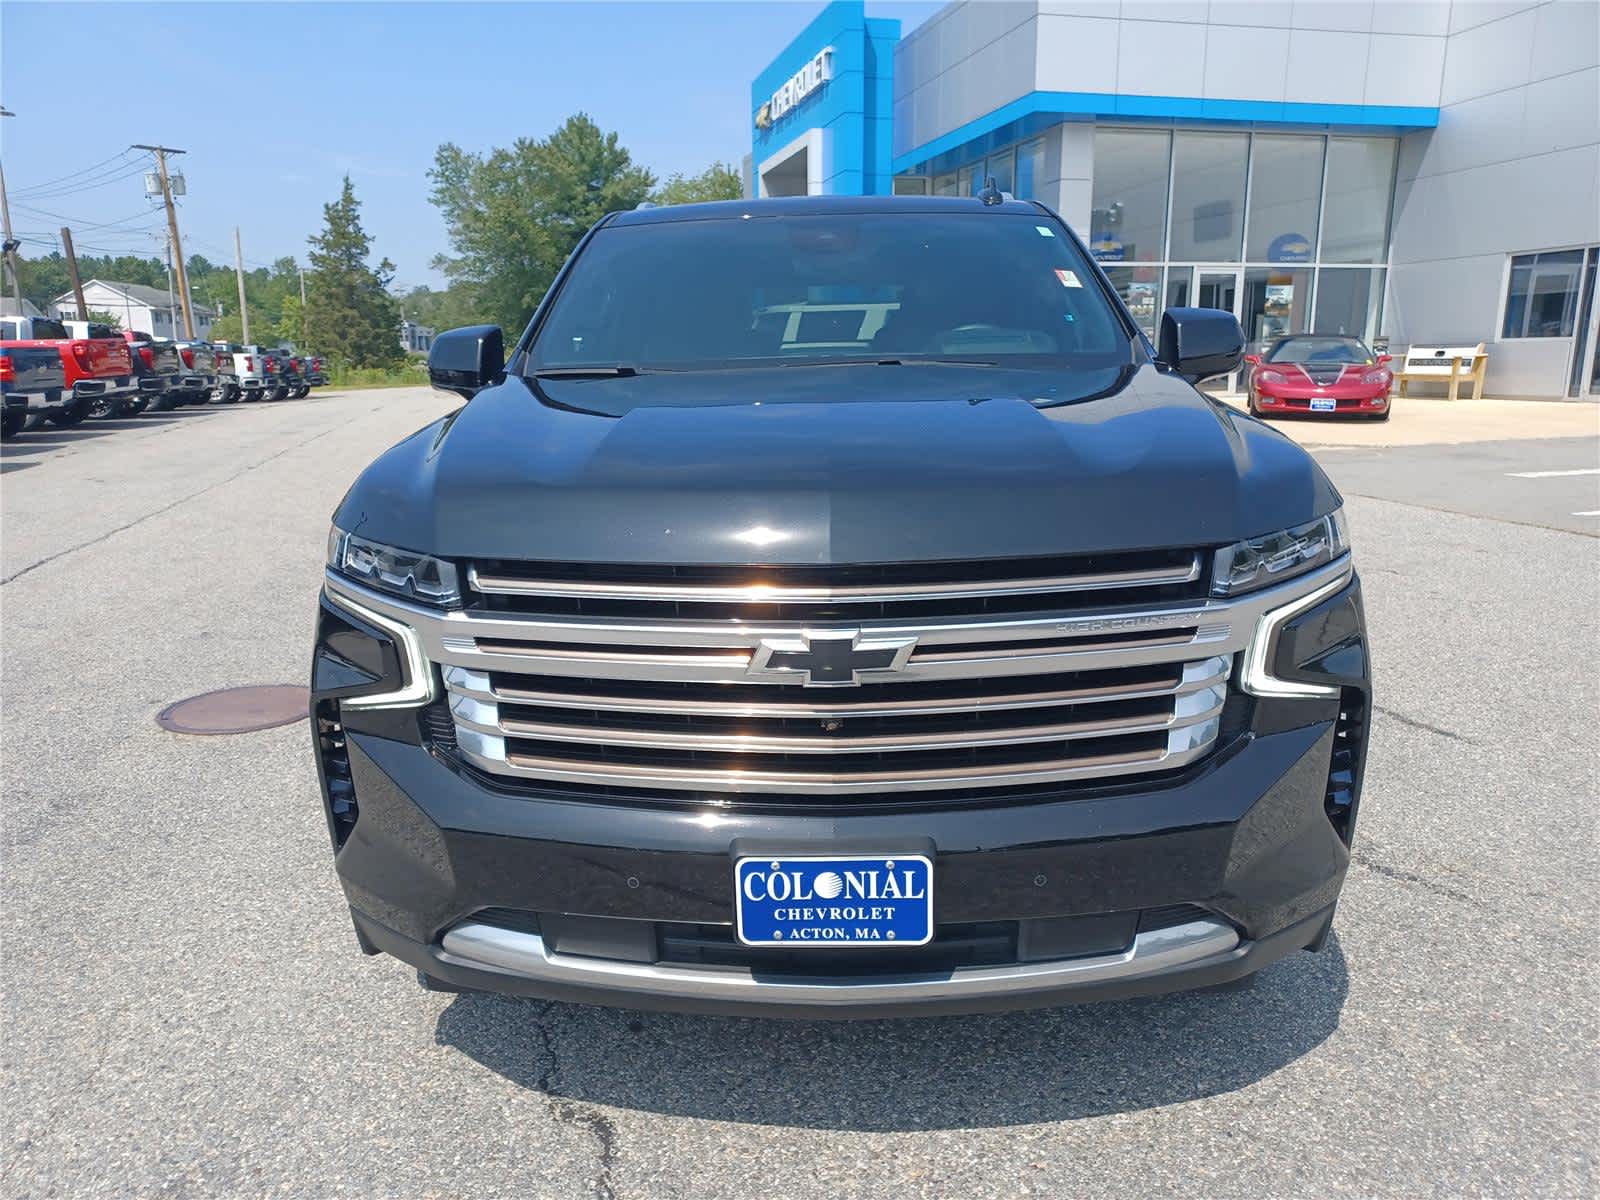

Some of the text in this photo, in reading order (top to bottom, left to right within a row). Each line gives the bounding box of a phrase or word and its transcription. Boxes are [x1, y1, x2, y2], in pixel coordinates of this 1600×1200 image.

[771, 46, 834, 121] CHEVROLET
[744, 871, 925, 901] COLONIAL
[774, 907, 896, 921] CHEVROLET
[789, 928, 881, 940] ACTON, MA
